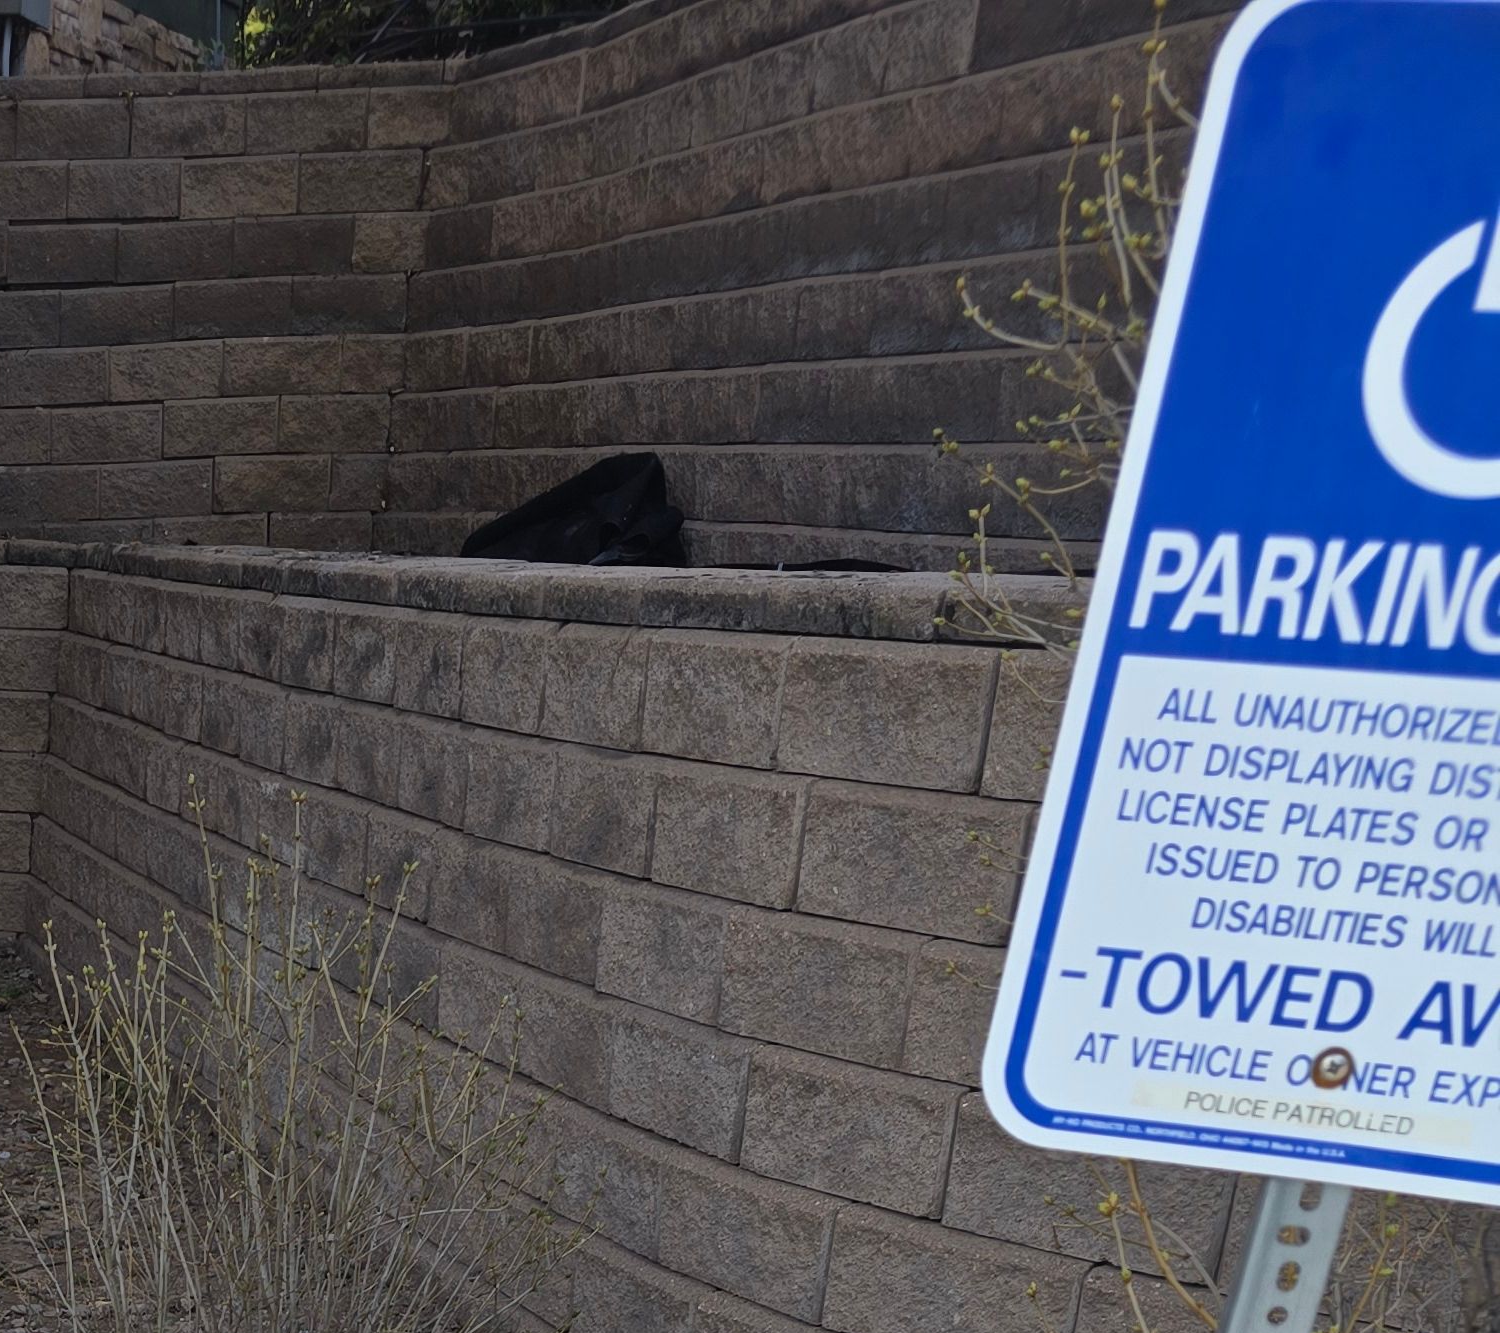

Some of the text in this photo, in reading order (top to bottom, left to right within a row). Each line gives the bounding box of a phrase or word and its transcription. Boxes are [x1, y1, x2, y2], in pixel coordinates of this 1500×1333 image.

[1157, 687, 1500, 746] ALL UNAUTHORIZE
[1117, 737, 1500, 801] NOT DISPLAYING DIS
[1116, 788, 1489, 852] LICENSE PLATES OR
[1145, 842, 1500, 907] ISSUED TO PERSON
[1190, 896, 1496, 958] DISABILITIES WILL
[1074, 1032, 1119, 1065] AT
[1131, 1036, 1273, 1083] VEHICLE
[1286, 1053, 1417, 1099] ONER
[1183, 1091, 1415, 1137] POLICE PATROLLED
